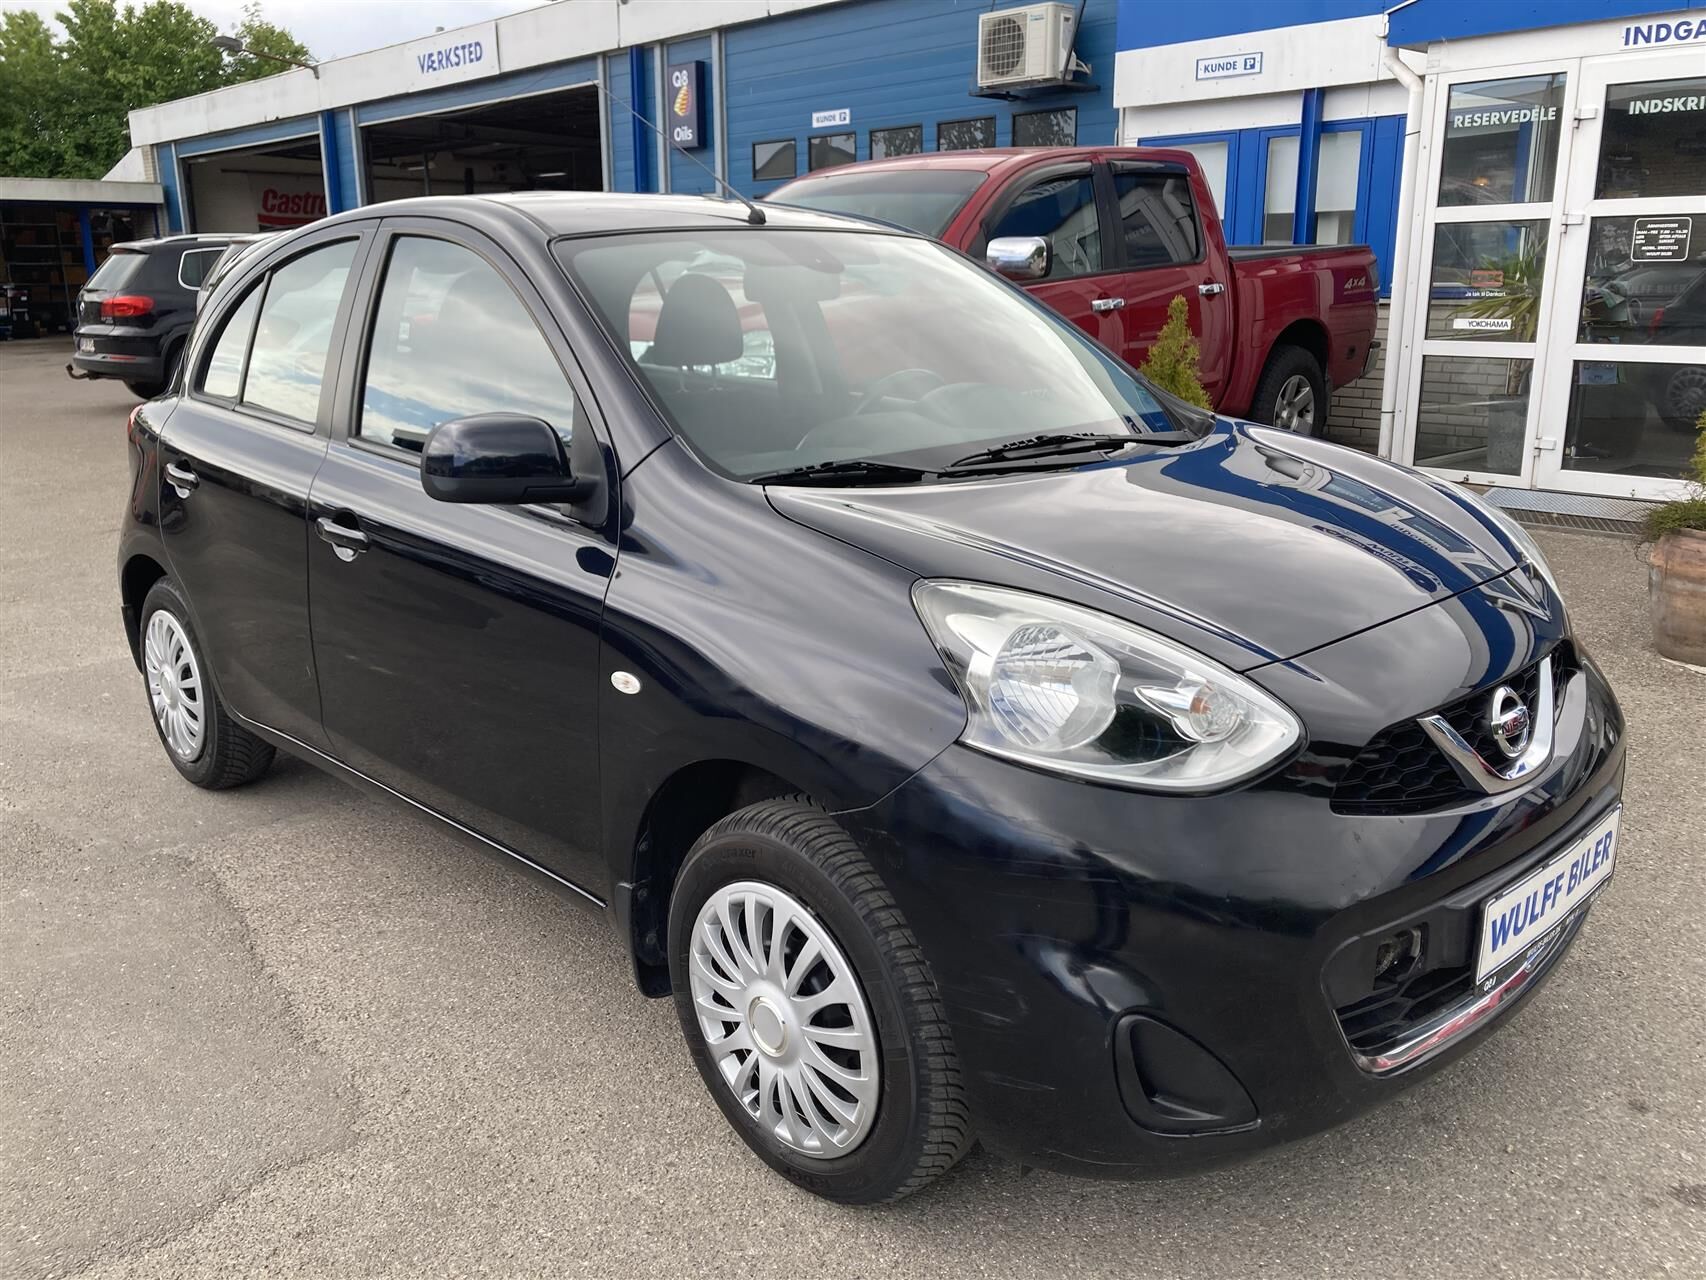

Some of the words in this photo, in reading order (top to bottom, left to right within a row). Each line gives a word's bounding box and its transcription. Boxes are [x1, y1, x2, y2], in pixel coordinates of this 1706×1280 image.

[417, 41, 483, 74] VÆRKSTED
[1203, 60, 1238, 74] KUNDE
[672, 70, 689, 87] Q8
[1453, 106, 1557, 129] RESERVEDELE
[674, 126, 693, 141] Oils
[1468, 320, 1509, 328] YOKOHAMA
[1491, 871, 1566, 953] WULFF
[1566, 830, 1613, 897] BILER
